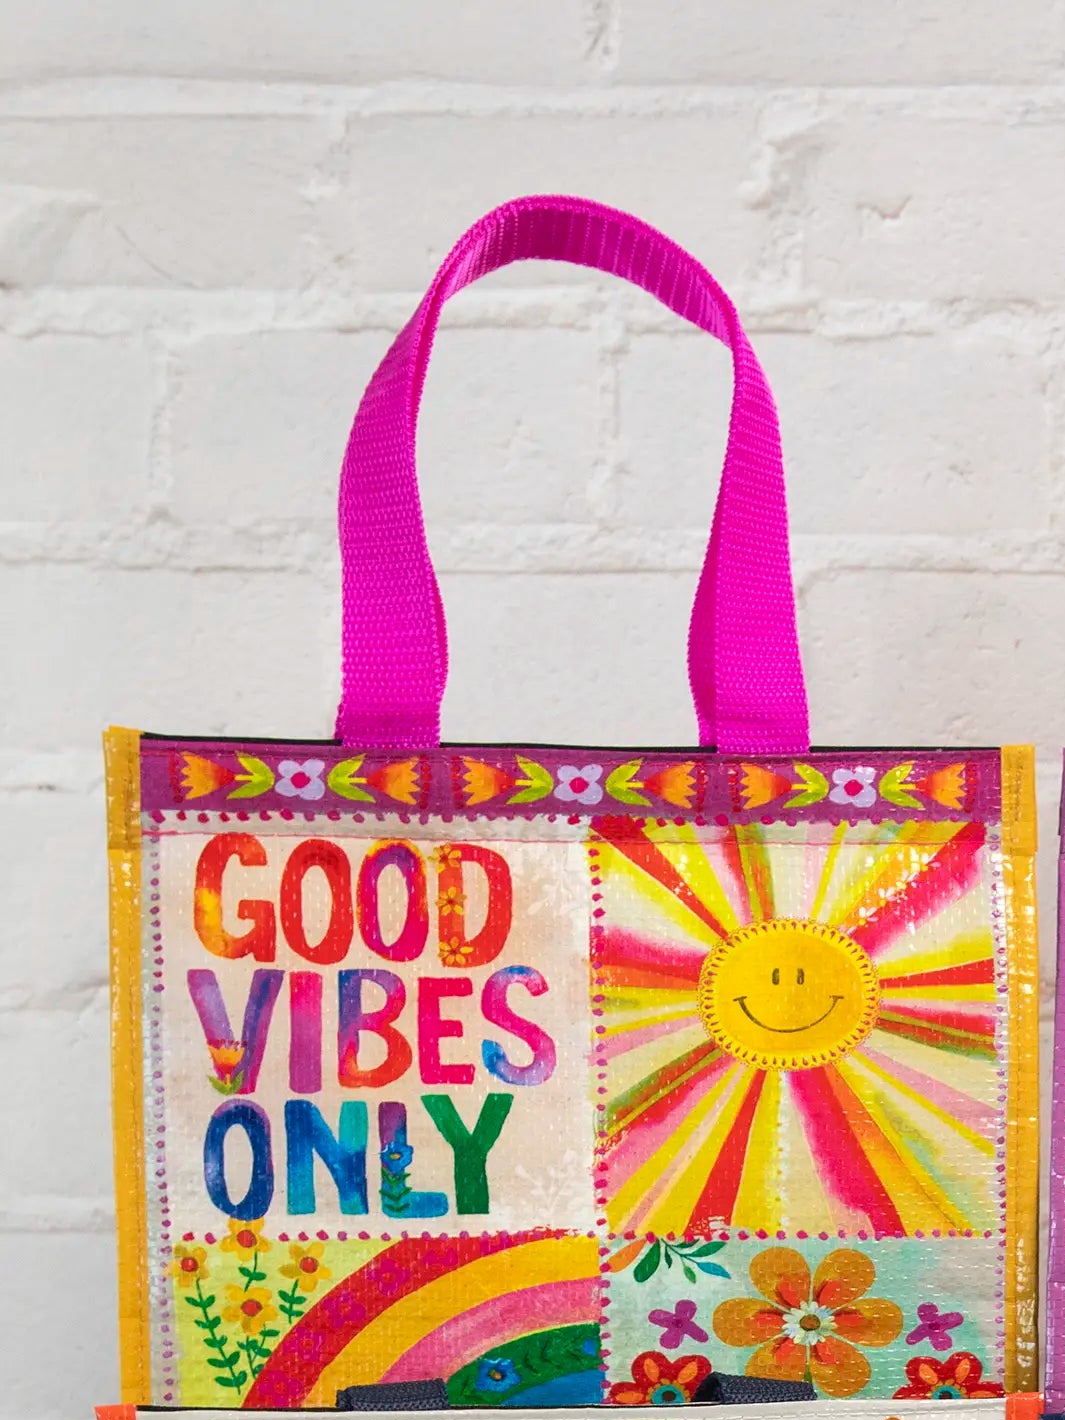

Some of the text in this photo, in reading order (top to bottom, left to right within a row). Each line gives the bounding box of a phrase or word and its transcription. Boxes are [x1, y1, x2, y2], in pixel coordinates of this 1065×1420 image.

[194, 832, 511, 968] GOOD
[187, 965, 556, 1094] VIBES
[204, 1093, 514, 1221] ONLY
